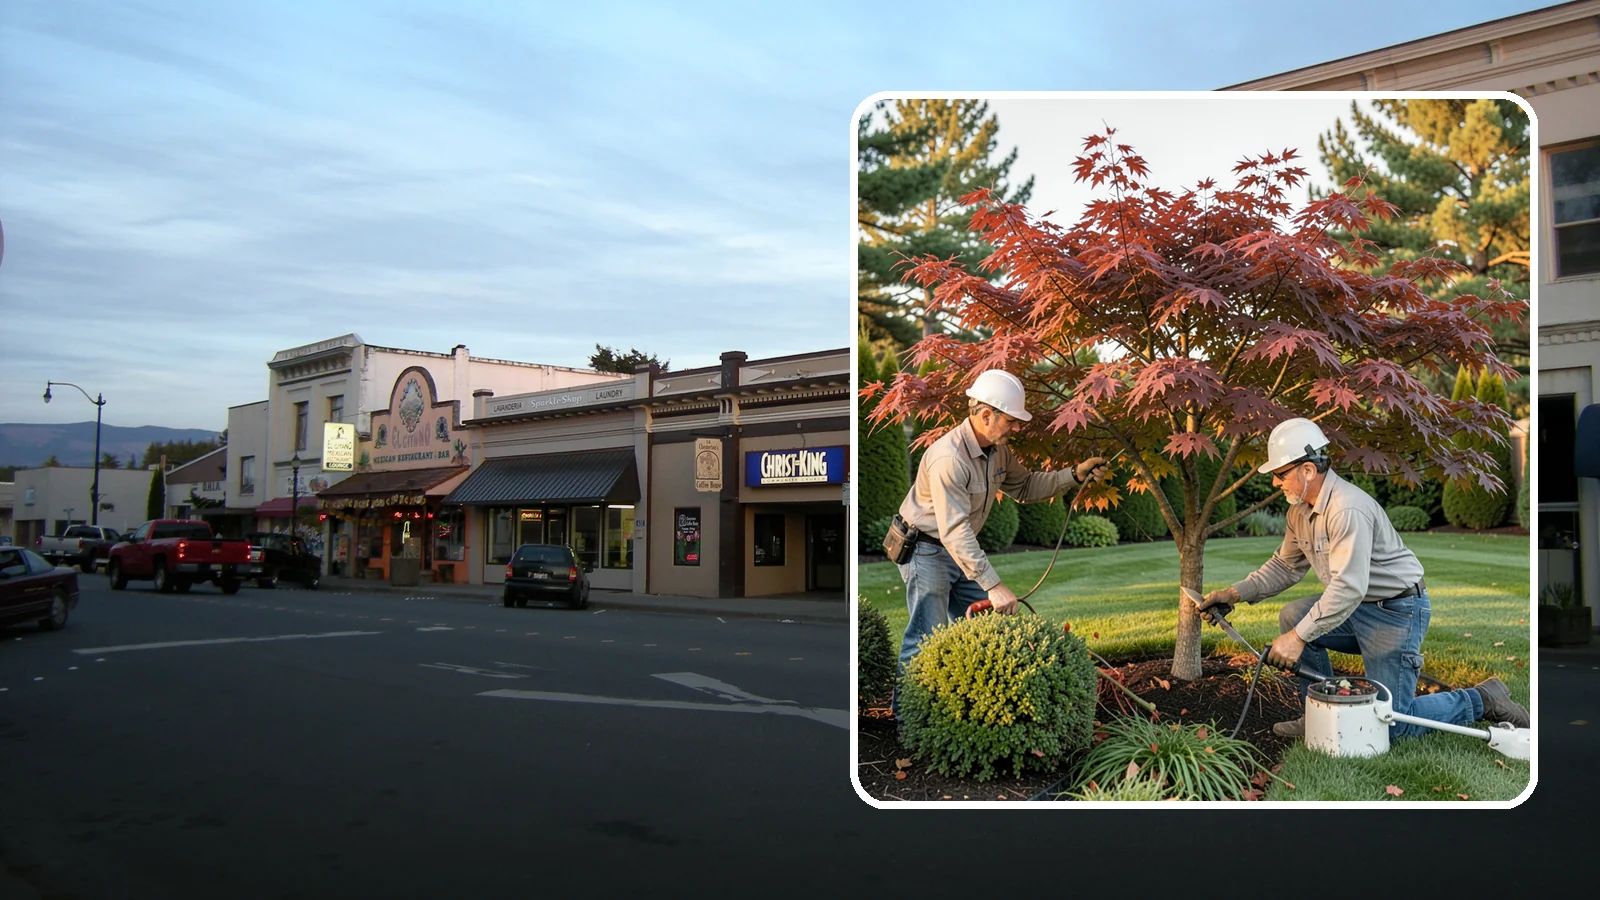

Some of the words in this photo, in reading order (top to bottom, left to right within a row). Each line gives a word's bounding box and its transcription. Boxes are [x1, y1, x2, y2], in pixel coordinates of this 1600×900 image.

[530, 398, 560, 409] Sparkle
[561, 394, 582, 404] Shop
[596, 389, 623, 400] LAUNDRY
[493, 402, 522, 412] LAVANDERIA
[392, 425, 401, 449] EL
[373, 455, 396, 464] MEXICAN
[397, 451, 433, 462] RESTAURANT
[438, 450, 450, 459] BAR
[799, 450, 827, 476] KING
